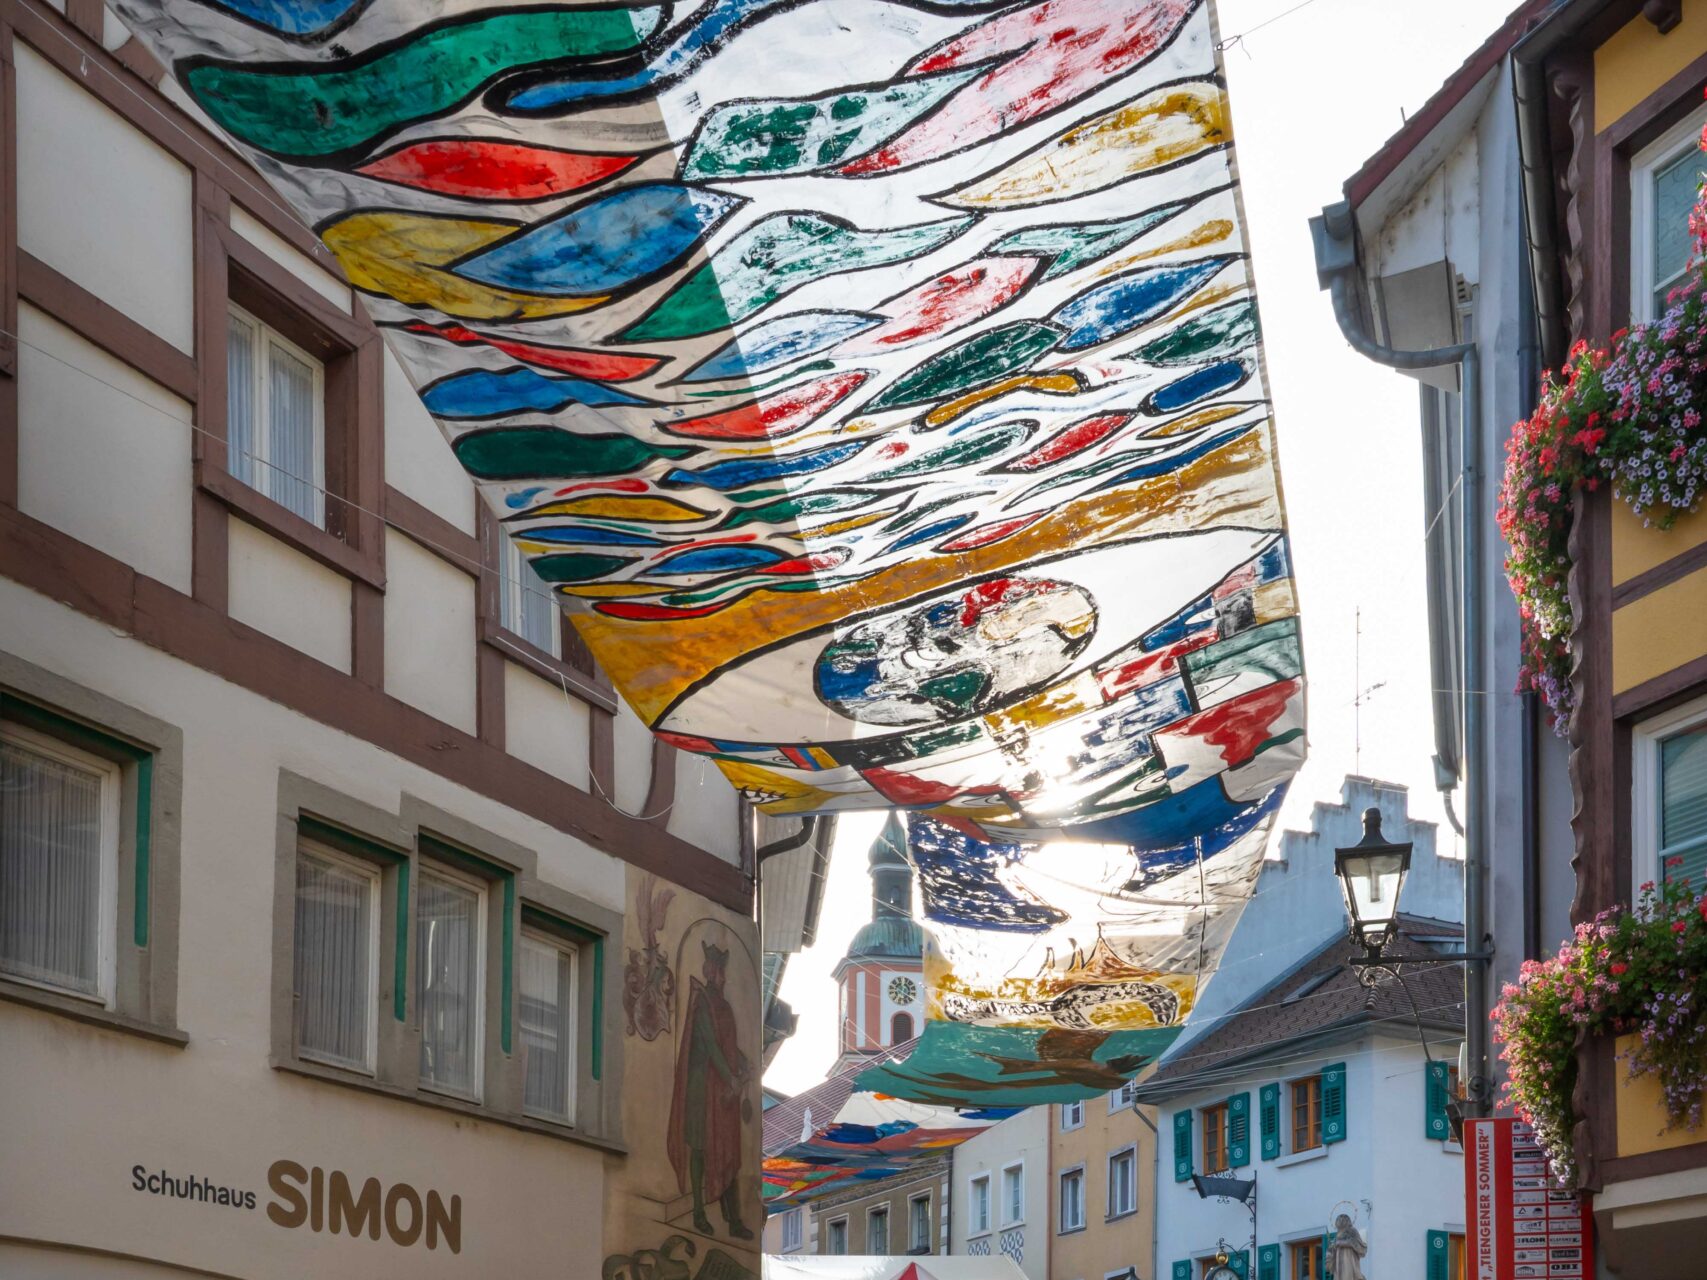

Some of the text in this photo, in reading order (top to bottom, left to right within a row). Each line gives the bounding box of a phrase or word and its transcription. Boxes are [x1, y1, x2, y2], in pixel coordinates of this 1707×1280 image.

[132, 1160, 461, 1255] Schuhhaus SIMON
[1479, 1195, 1493, 1272] „TIENGENER
